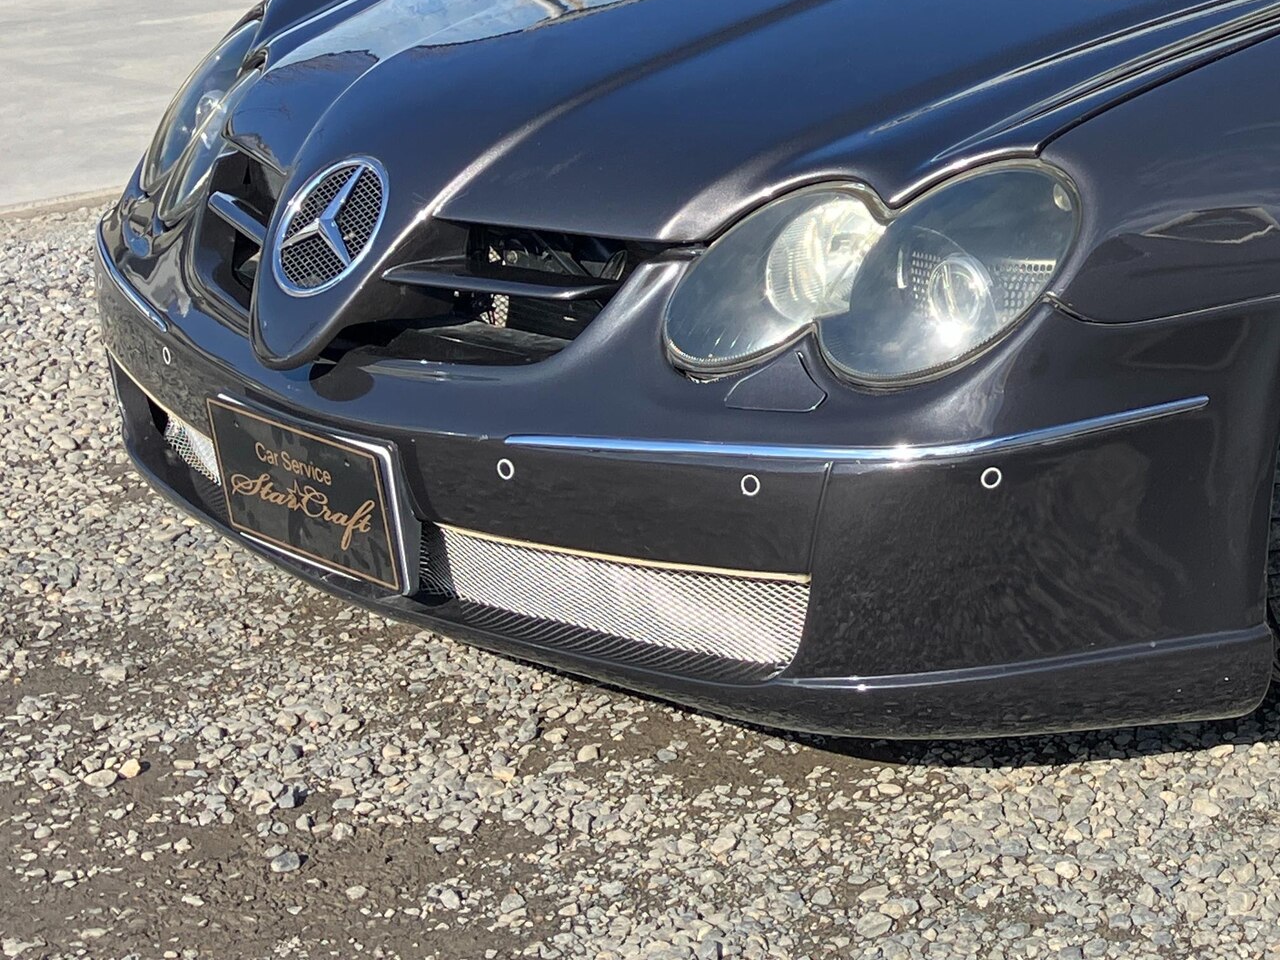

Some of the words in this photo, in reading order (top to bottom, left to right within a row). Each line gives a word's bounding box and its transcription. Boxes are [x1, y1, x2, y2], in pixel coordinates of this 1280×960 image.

[255, 442, 279, 467] Car
[280, 451, 332, 486] Service
[301, 485, 376, 551] Craft
